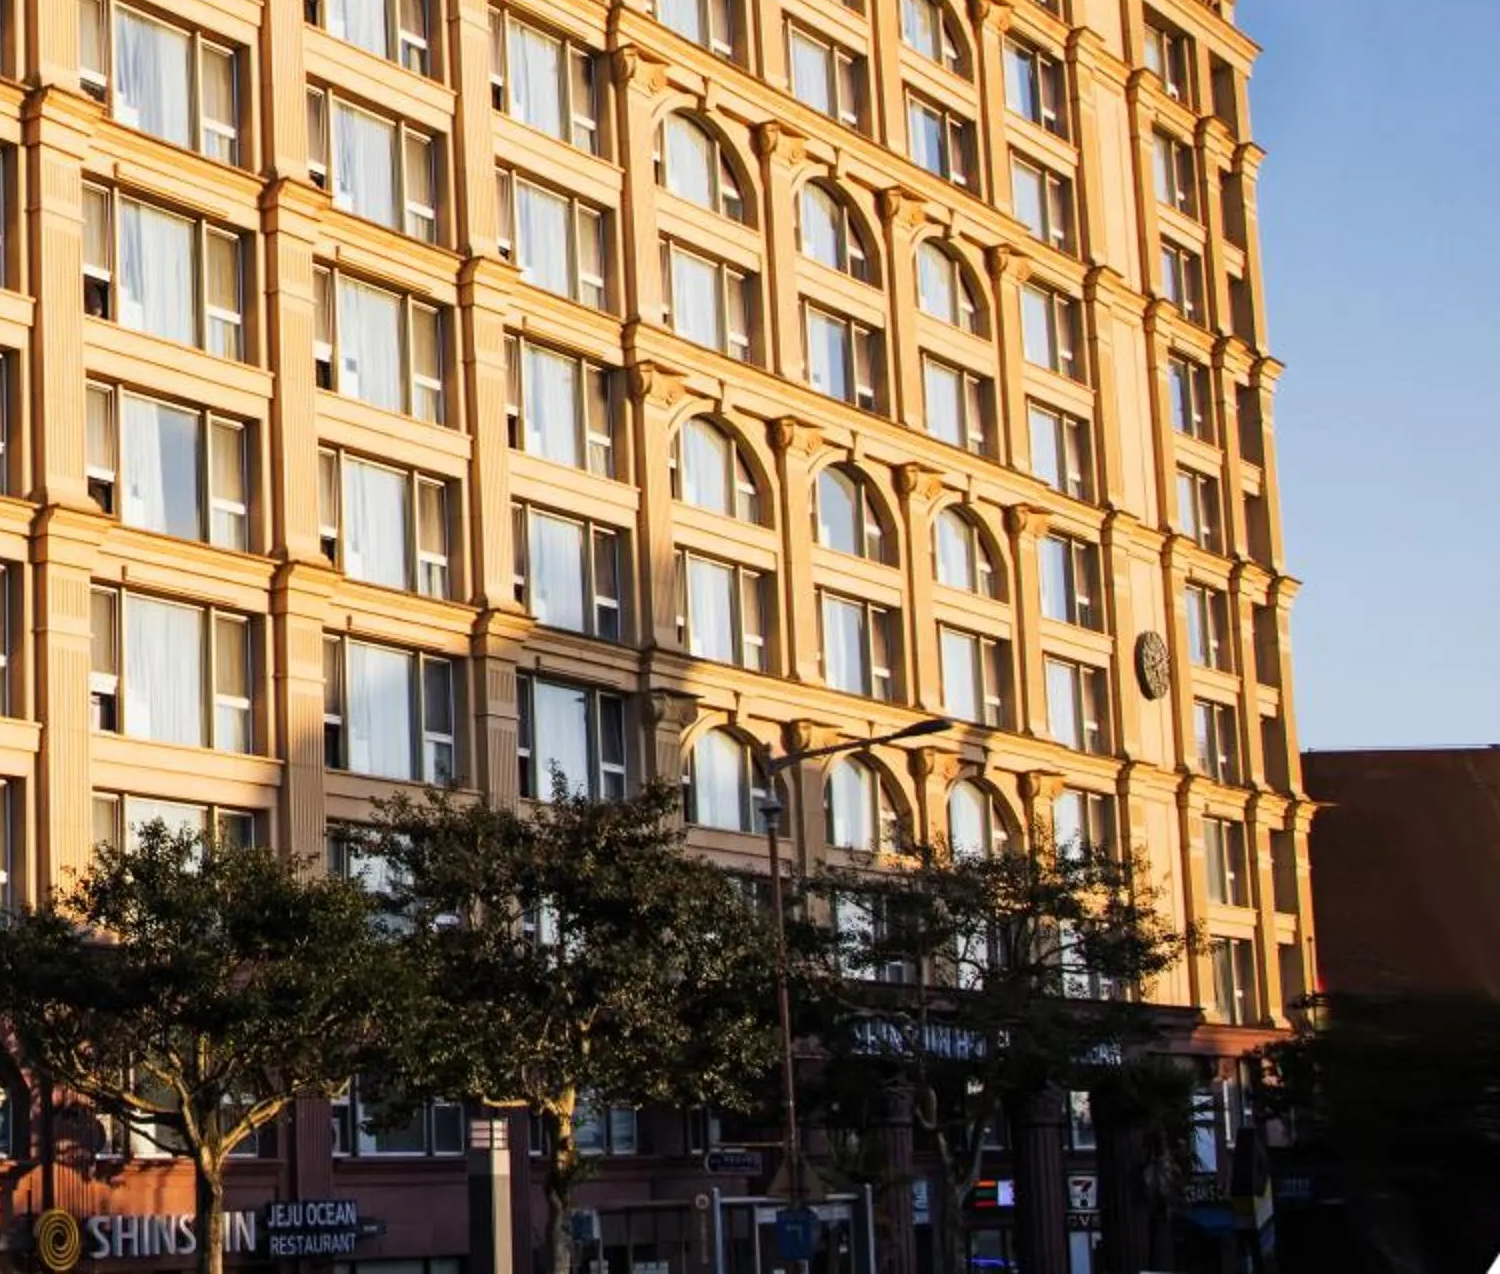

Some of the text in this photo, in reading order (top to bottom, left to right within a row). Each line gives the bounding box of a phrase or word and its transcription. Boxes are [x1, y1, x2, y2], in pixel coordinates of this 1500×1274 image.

[268, 1202, 357, 1227] JEJU OCEAN
[87, 1211, 257, 1259] SHINSIN
[270, 1233, 356, 1255] RESTAURANT
